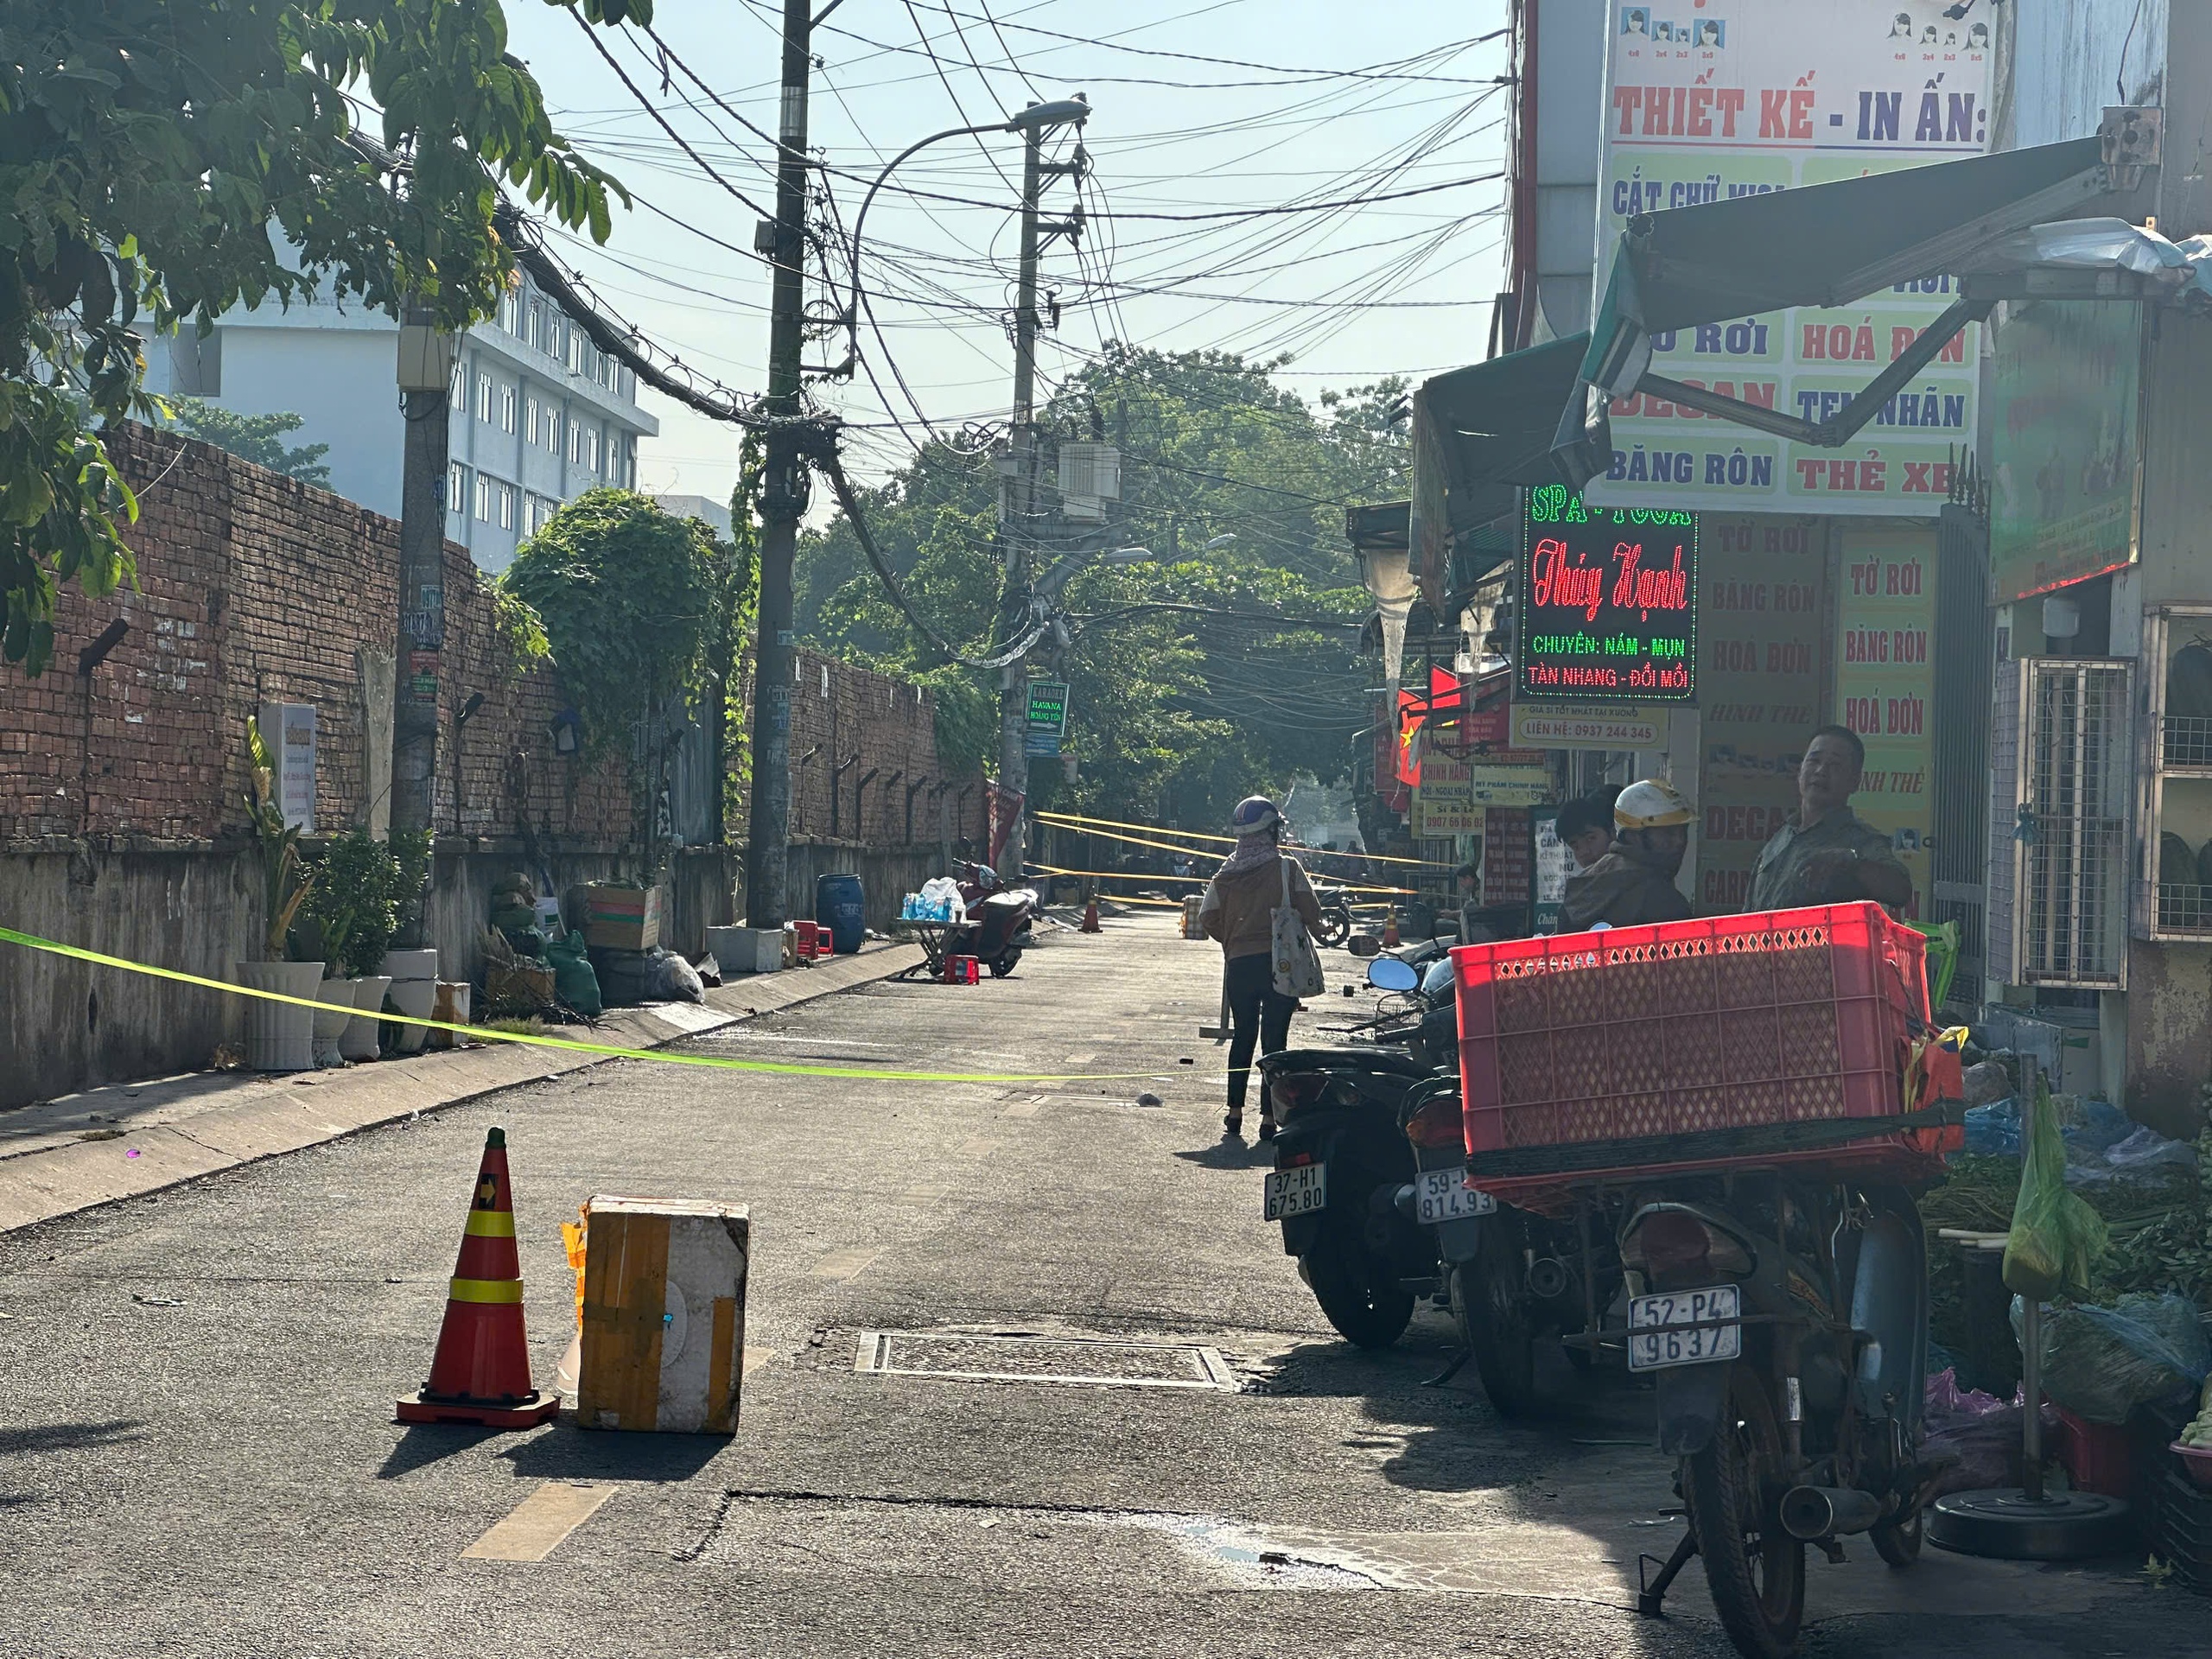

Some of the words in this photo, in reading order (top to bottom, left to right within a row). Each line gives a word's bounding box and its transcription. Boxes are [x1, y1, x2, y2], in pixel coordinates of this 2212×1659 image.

[1613, 68, 1745, 137] THIẾT
[1759, 70, 1815, 138] KẾ
[1829, 114, 1843, 127] -
[1857, 92, 1902, 141] IN
[1915, 72, 1986, 143] ẤN:
[1612, 165, 1662, 216] CẮT
[1669, 174, 1721, 208] CHỮ
[1694, 318, 1768, 355] RƠI
[1802, 315, 1876, 361] HOÁ
[1877, 386, 1965, 428] NHÃN
[1605, 444, 1694, 484] BĂNG
[1704, 447, 1772, 486] RÔN
[1796, 449, 1887, 492] THẺ
[1532, 485, 1588, 523] SPA
[1718, 518, 1755, 553] TỜ
[1764, 522, 1809, 554] RƠI
[1533, 538, 1603, 622] Thúy
[1612, 542, 1688, 622] Hạnh
[1851, 554, 1880, 595] TỜ
[1885, 556, 1922, 595] RƠI
[1533, 631, 1600, 654] CHUYÊN:
[1605, 632, 1638, 655] NÁM
[1651, 638, 1685, 660] MỤN
[1713, 634, 1758, 672] HOÁ
[1765, 636, 1812, 674] ĐƠN
[1846, 623, 1889, 663] BĂNG
[1893, 623, 1927, 663] RÔN
[1528, 661, 1558, 684] TÀN
[1562, 667, 1617, 686] NHANG
[1032, 700, 1061, 711] HAVANA
[1846, 687, 1881, 734] HOÁ
[1887, 690, 1924, 735] ĐƠN
[1526, 721, 1550, 734] LIÊN
[1554, 721, 1572, 738] HỆ:
[1575, 726, 1602, 737] 0937
[1605, 727, 1628, 738] 244
[1630, 728, 1652, 739] 345
[1890, 766, 1926, 794] THẺ
[1427, 817, 1446, 828] 0907
[1707, 805, 1798, 841] DECA
[1274, 1168, 1316, 1194] 37-H1
[1427, 1170, 1468, 1195] 59-
[1269, 1187, 1322, 1217] 675.80
[1422, 1191, 1491, 1218] 814.93
[1645, 1292, 1723, 1326] 52-P4
[1646, 1327, 1722, 1363] 9637
